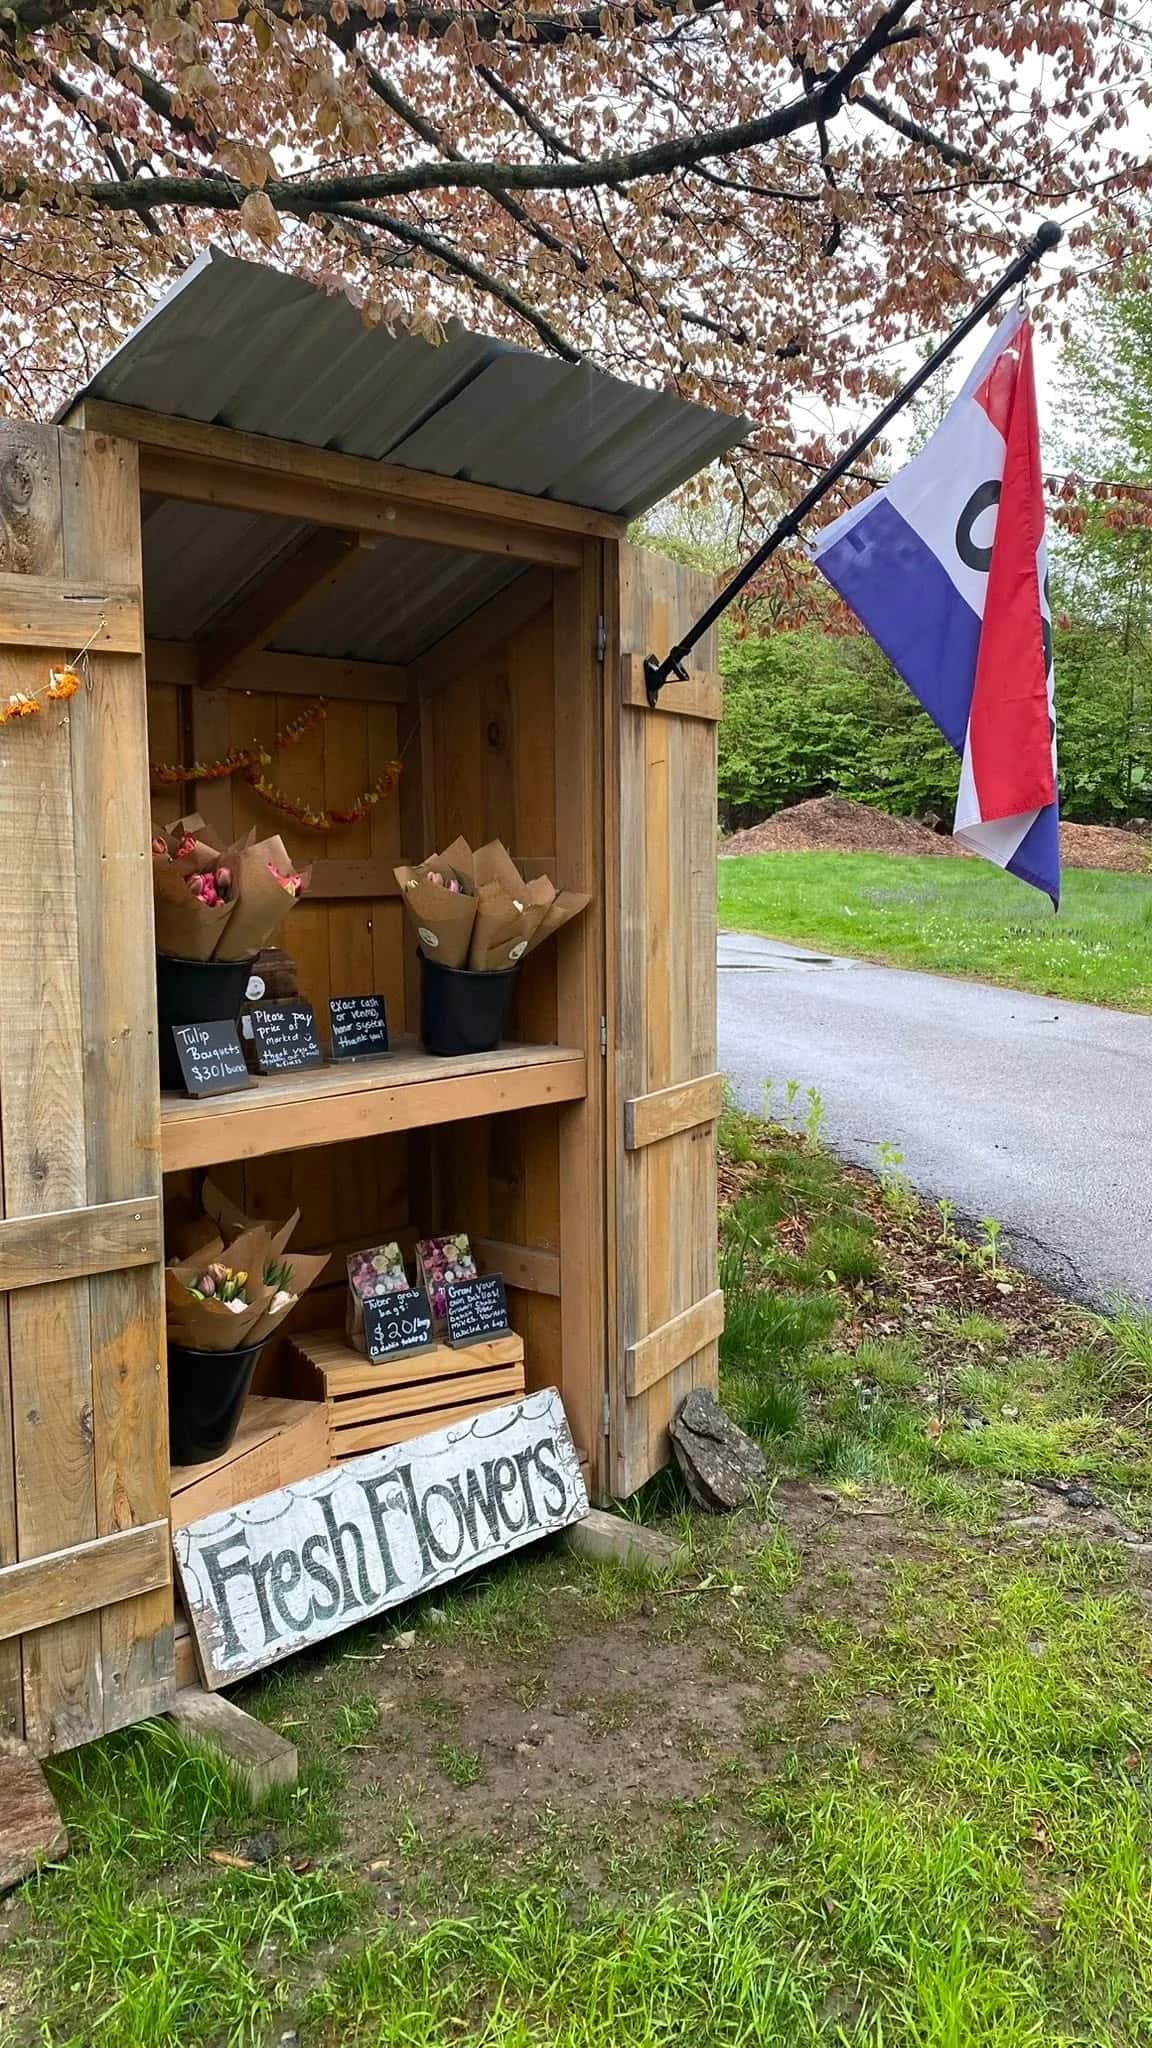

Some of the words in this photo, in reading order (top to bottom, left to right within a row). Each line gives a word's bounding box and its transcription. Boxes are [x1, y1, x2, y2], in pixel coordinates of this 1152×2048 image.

[253, 1010, 285, 1023] Please
[336, 1012, 346, 1021] or
[176, 1026, 209, 1046] Tulip
[186, 1043, 240, 1061] Bouquets
[396, 1289, 420, 1305] grab
[198, 1491, 380, 1660] Fresh
[357, 1438, 568, 1592] Flowers
